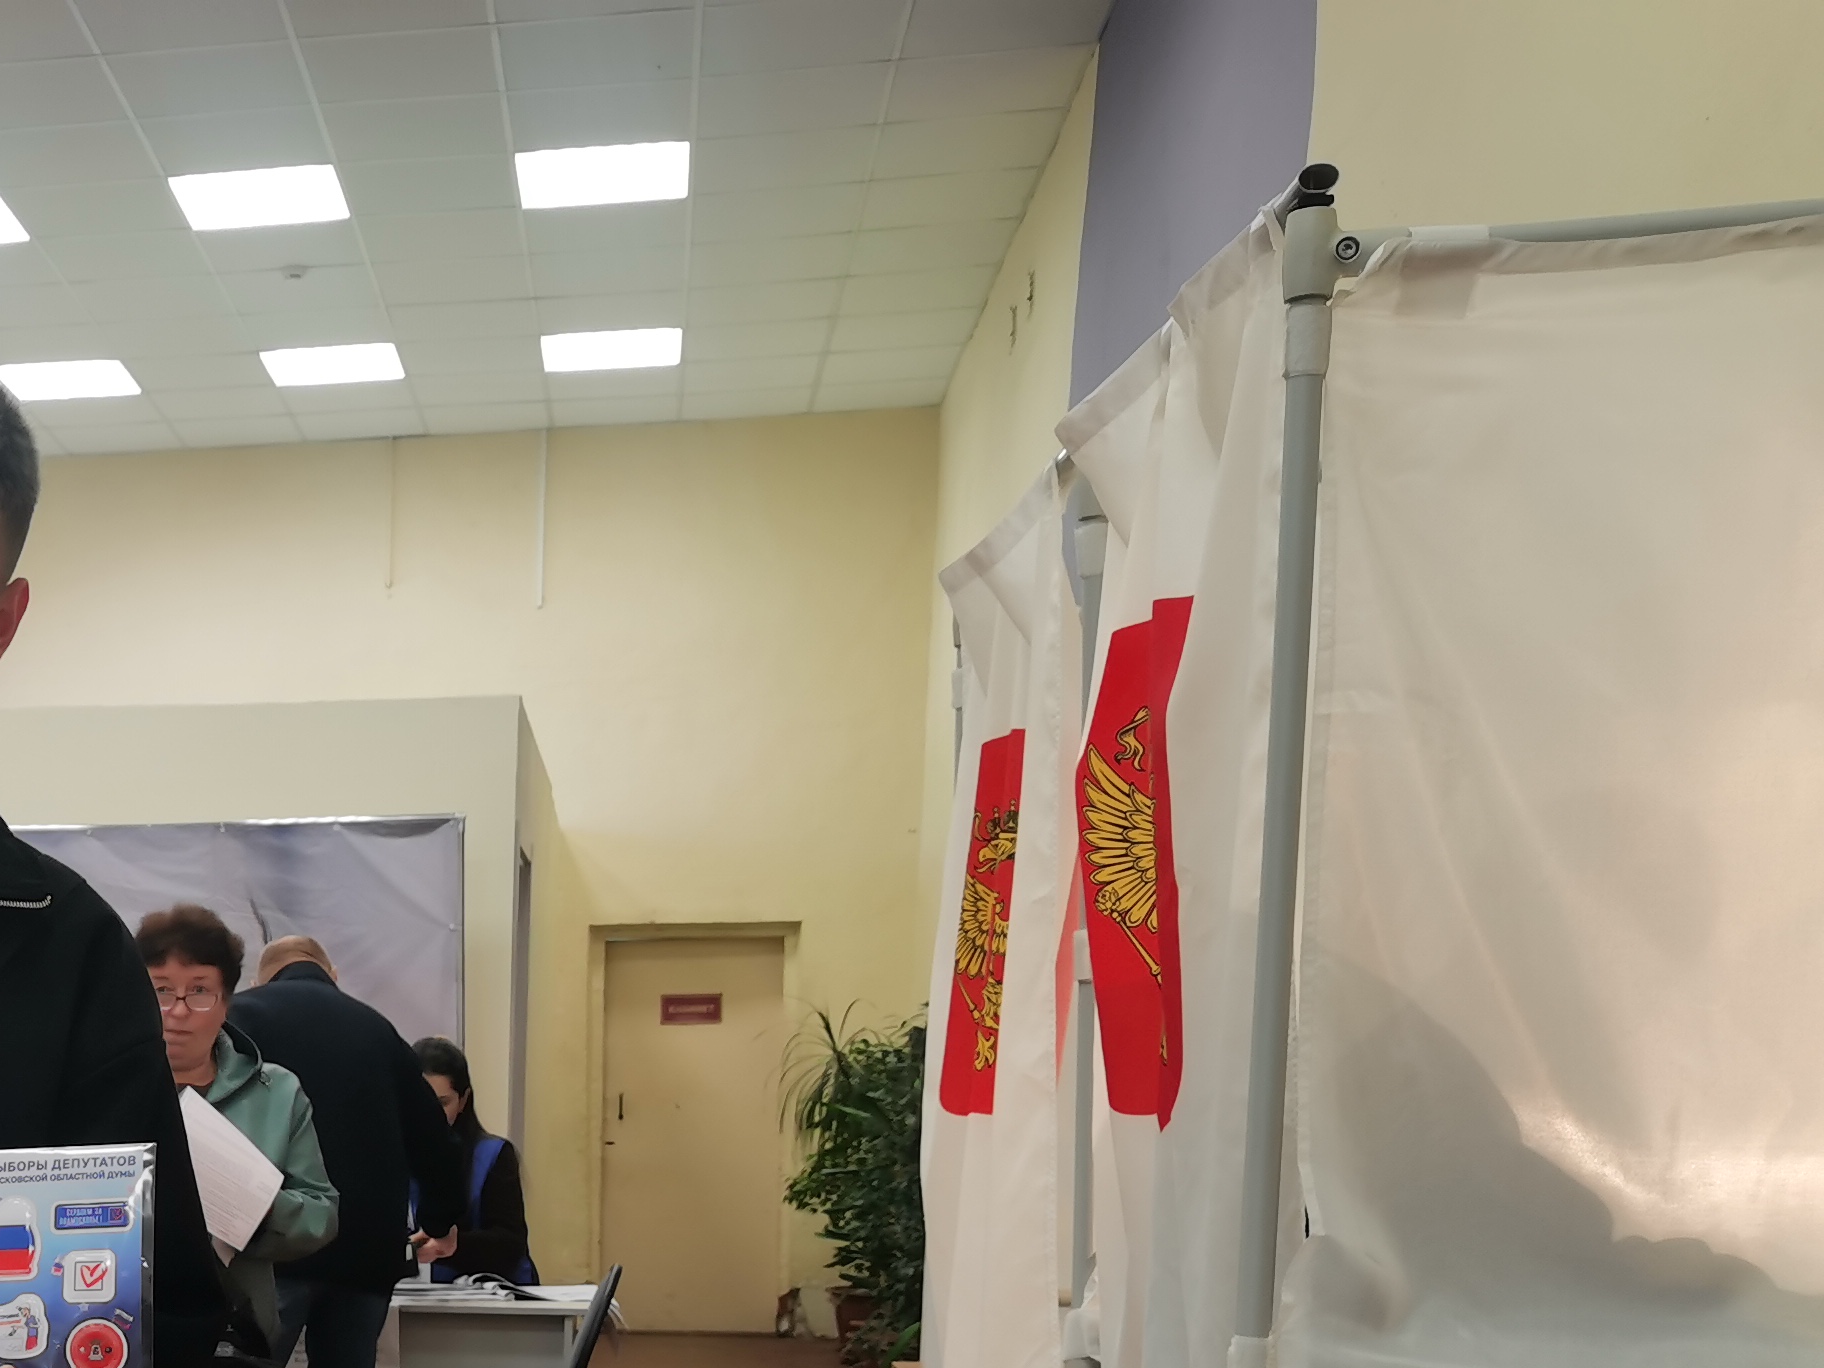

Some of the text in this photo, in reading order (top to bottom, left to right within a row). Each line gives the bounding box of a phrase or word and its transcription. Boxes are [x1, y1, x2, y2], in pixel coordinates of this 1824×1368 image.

[51, 1155, 136, 1172] ДЕПУТАТОВ
[49, 1170, 105, 1182] ОБЛАСТНОЙ
[107, 1170, 136, 1180] ДУМЫ
